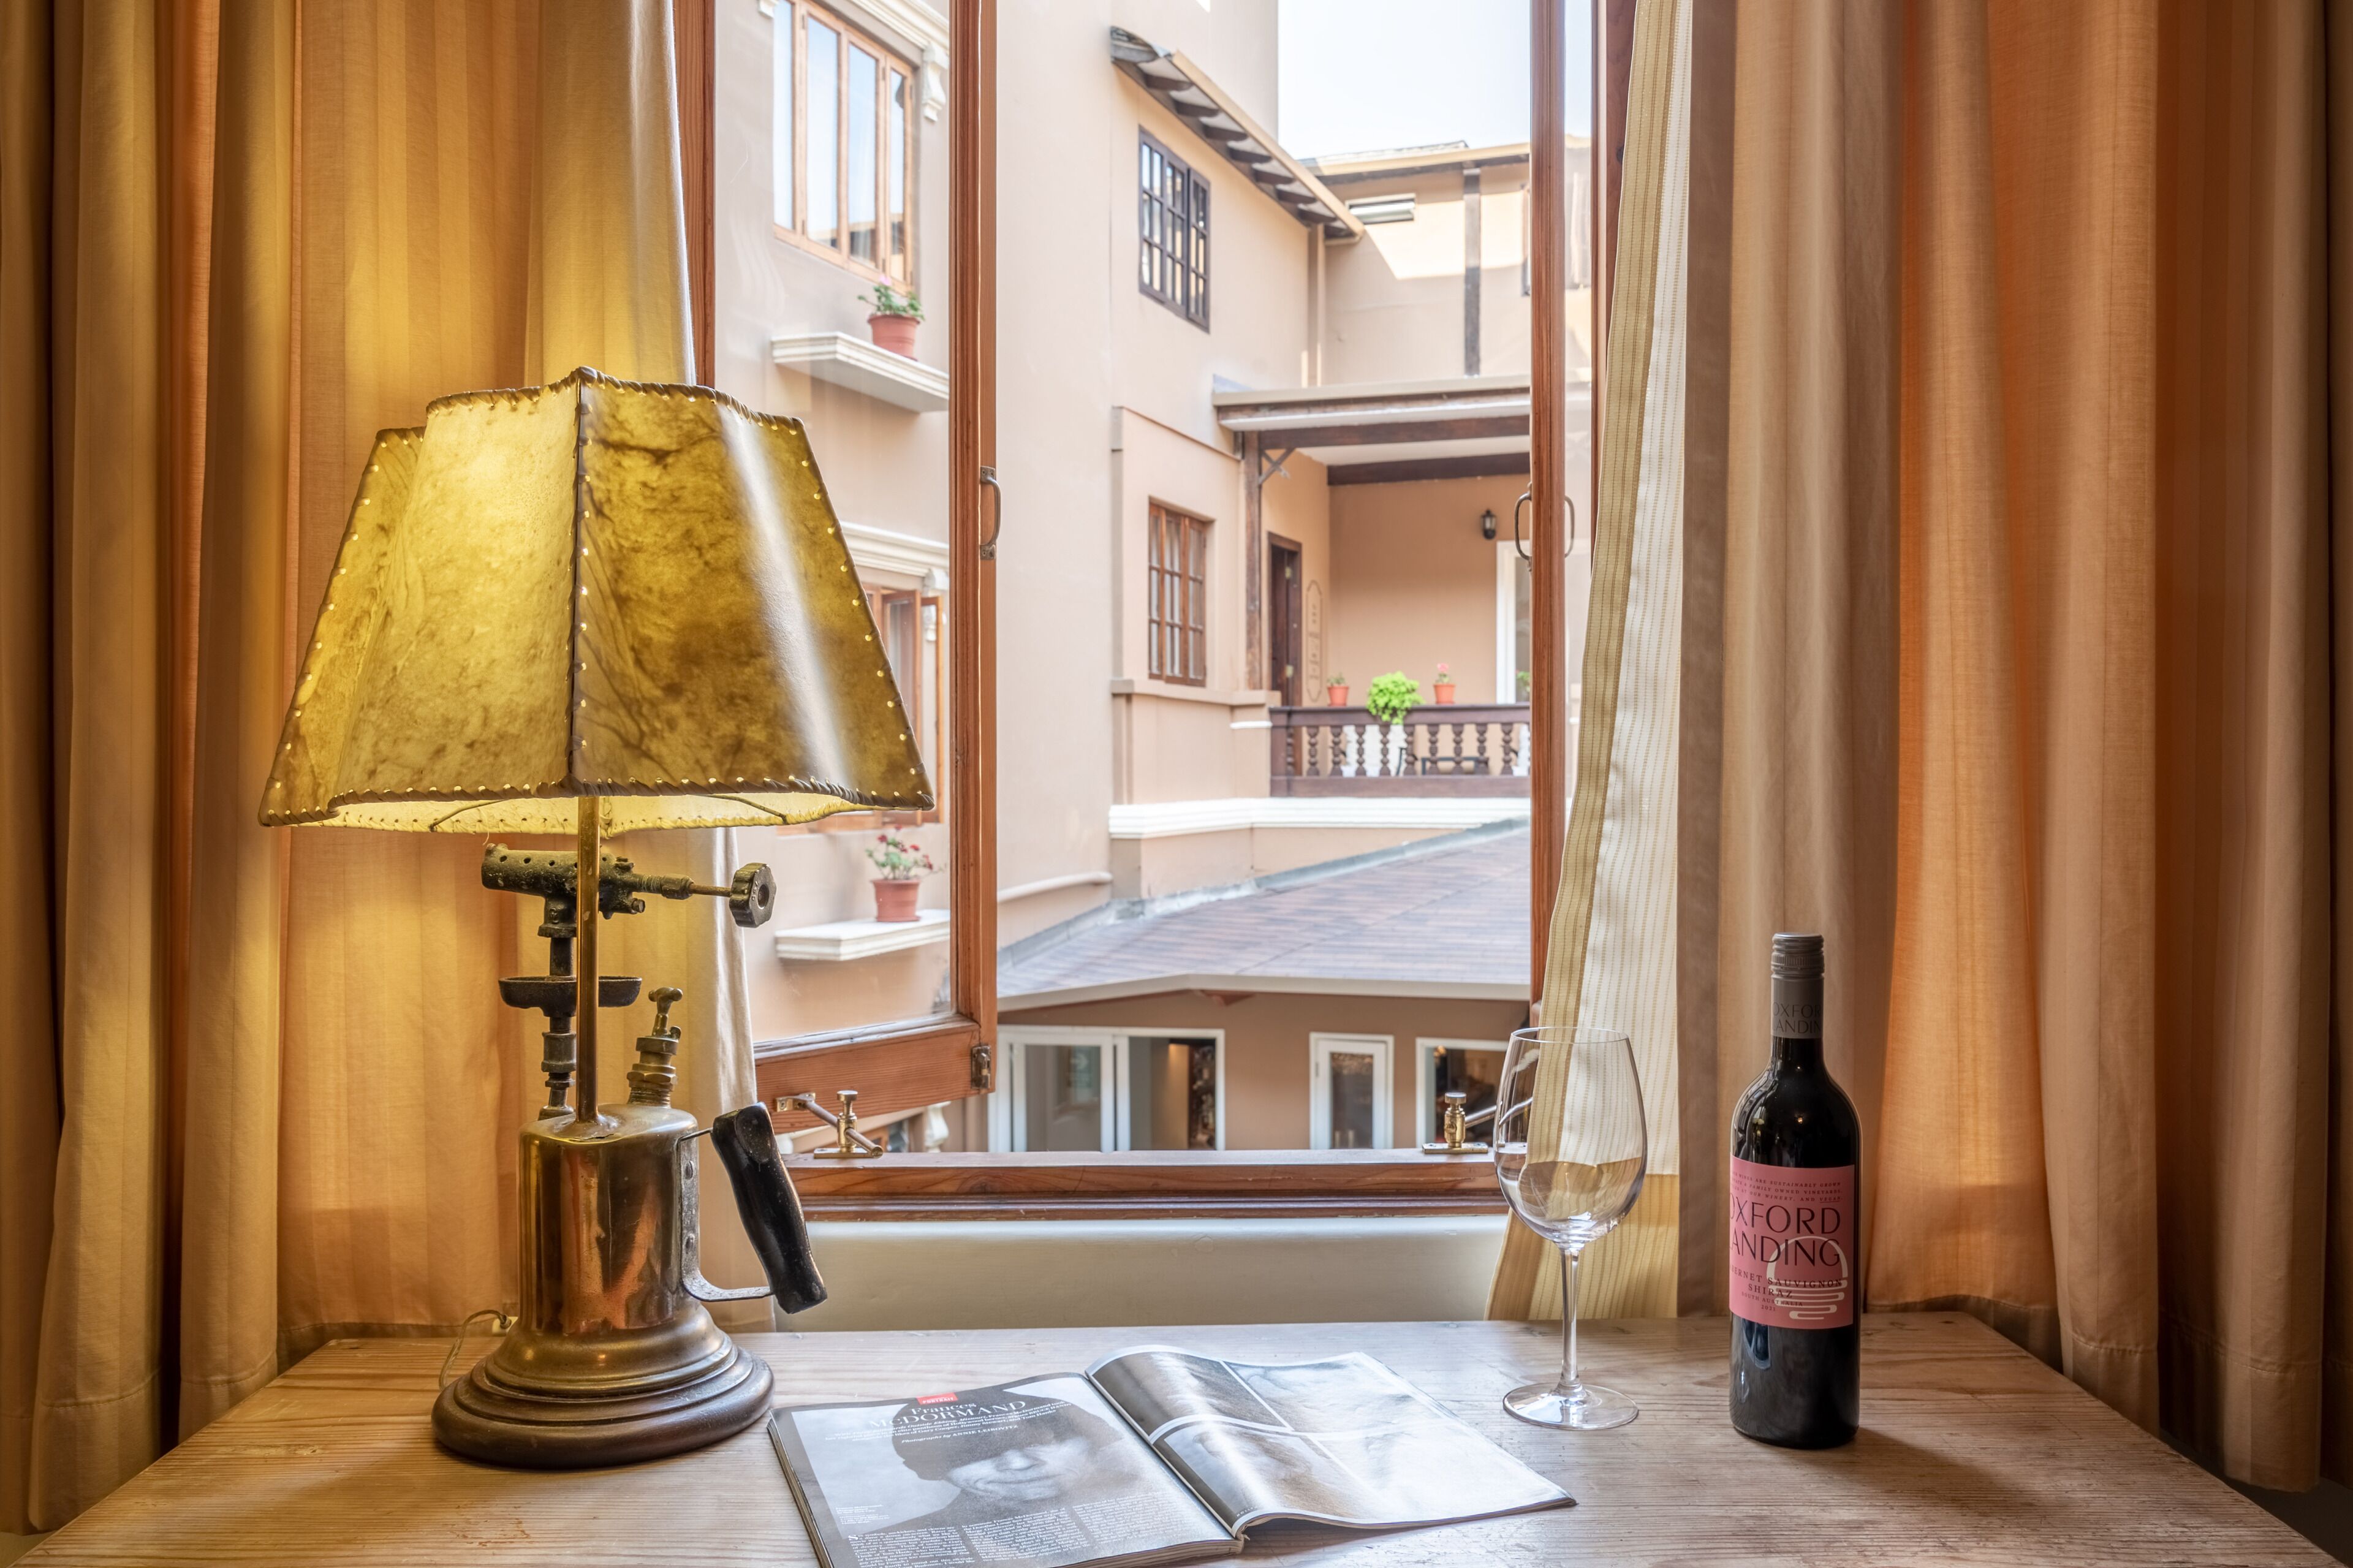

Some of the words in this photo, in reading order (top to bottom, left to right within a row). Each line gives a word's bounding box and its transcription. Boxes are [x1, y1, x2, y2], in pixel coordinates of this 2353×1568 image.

[1730, 1227, 1840, 1267] ANDING
[1748, 1283, 1792, 1298] SHIRAZ
[1768, 1277, 1842, 1289] SAUVIGNON
[1741, 1291, 1760, 1301] SOUTH
[1762, 1297, 1803, 1307] AUSTRALIA
[912, 1403, 977, 1415] Frances
